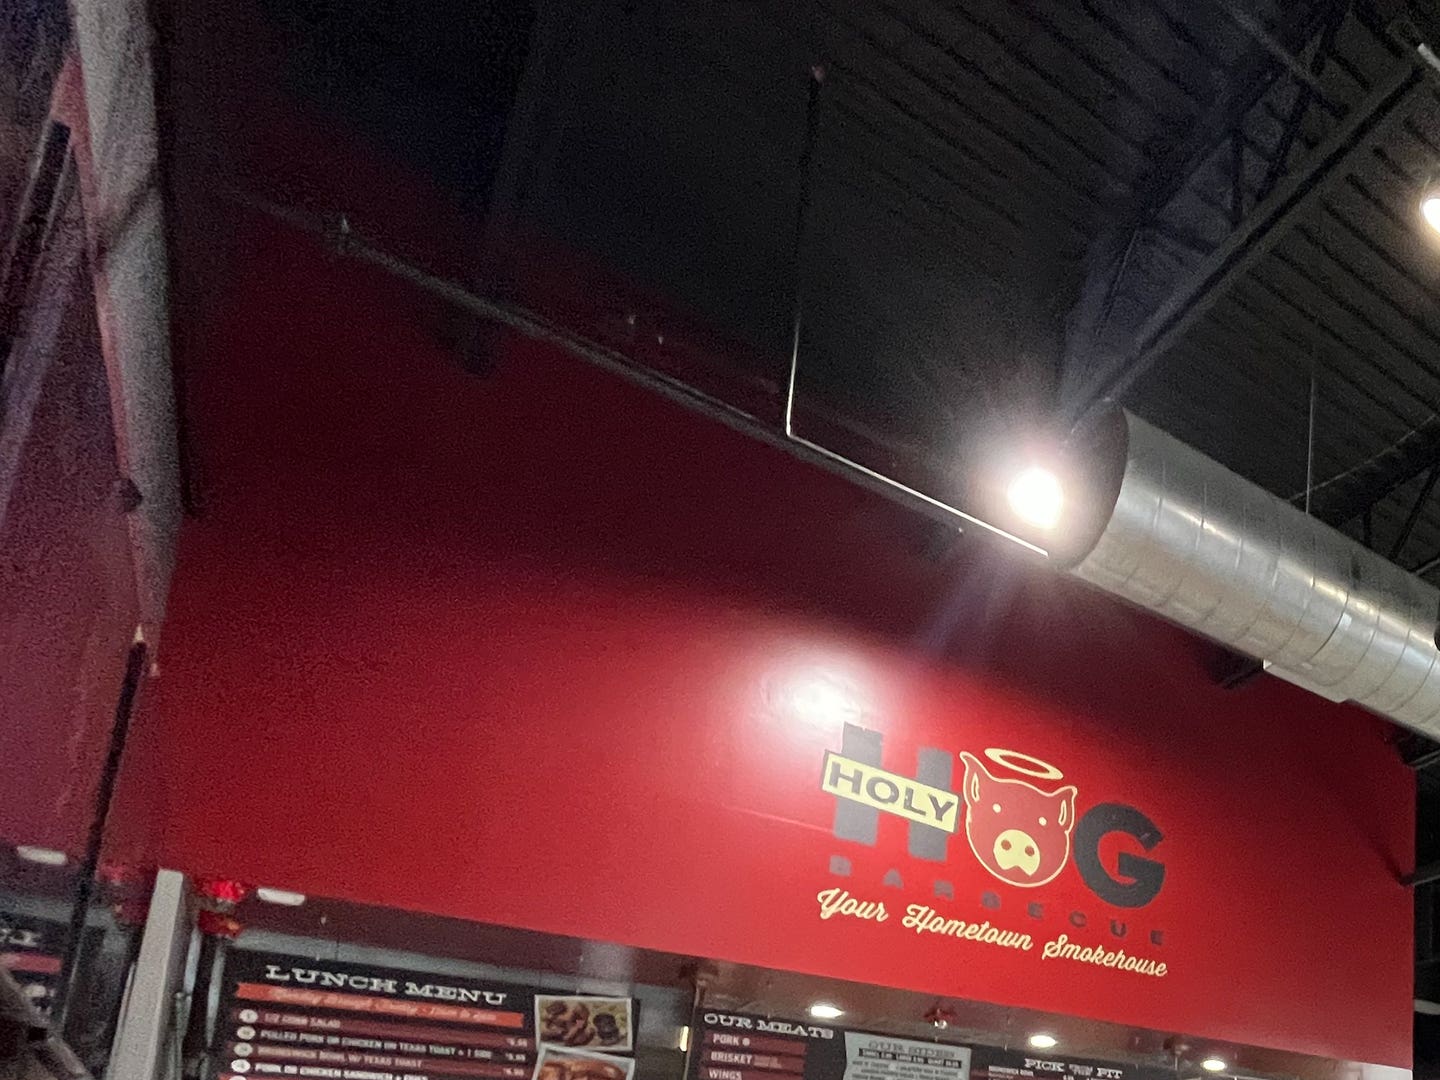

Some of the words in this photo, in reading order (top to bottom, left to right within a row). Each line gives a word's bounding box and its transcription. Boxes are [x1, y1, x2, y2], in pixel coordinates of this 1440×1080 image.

[827, 762, 956, 824] HOLY
[828, 854, 1166, 946] BARBECUE
[817, 887, 889, 922] Your
[902, 903, 1034, 951] Hometown
[1041, 934, 1168, 977] Smokehouse
[265, 964, 398, 993] LUNCH
[405, 981, 507, 1006] MENU
[704, 1012, 753, 1029] OUR
[756, 1019, 834, 1039] MEATS
[713, 1033, 740, 1046] PORK
[711, 1051, 753, 1064] BRISKET
[1024, 1058, 1065, 1073] PICK
[1096, 1067, 1123, 1079] PIT
[708, 1068, 742, 1080] WINGS
